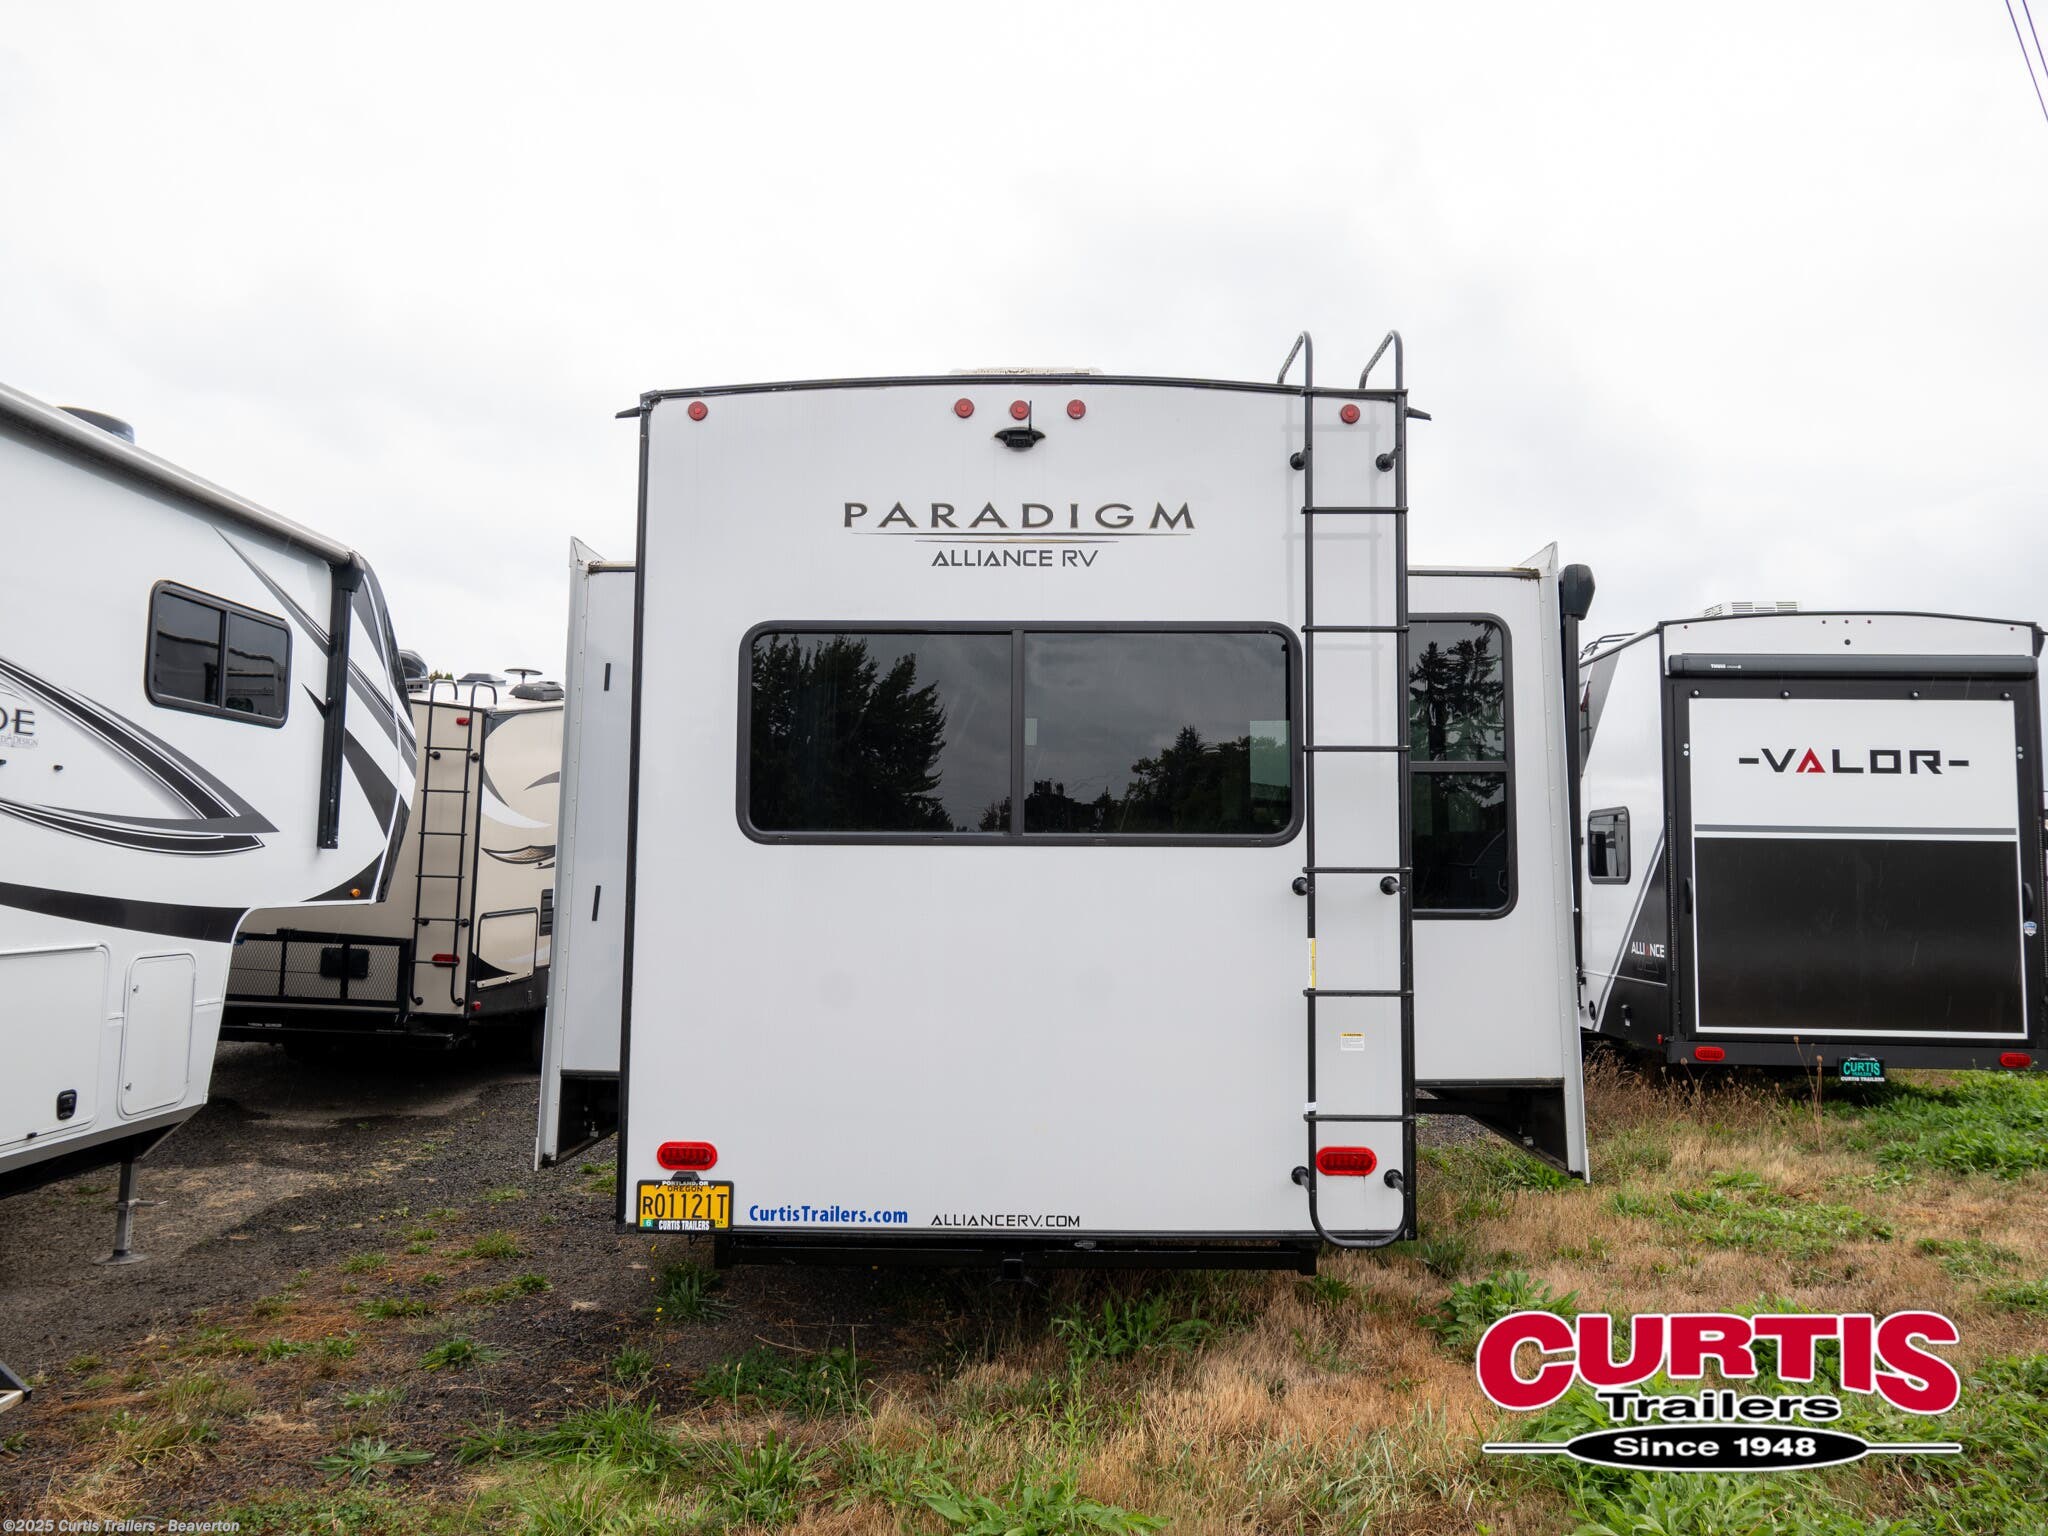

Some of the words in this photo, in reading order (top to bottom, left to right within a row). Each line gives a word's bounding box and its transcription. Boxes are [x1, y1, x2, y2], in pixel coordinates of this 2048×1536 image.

[844, 501, 1195, 530] PARADIGM
[931, 550, 1053, 567] ALLIANCE
[1062, 550, 1099, 567] RV
[1631, 941, 1665, 958] ALLIANCE
[1843, 1062, 1880, 1076] CURTIS
[642, 1193, 728, 1219] R01121T
[749, 1205, 908, 1224] CurtisTrailers.com
[658, 1220, 680, 1231] CURTIS
[682, 1220, 710, 1231] TRAILERS
[930, 1214, 1080, 1228] ALLIANCERV.COM
